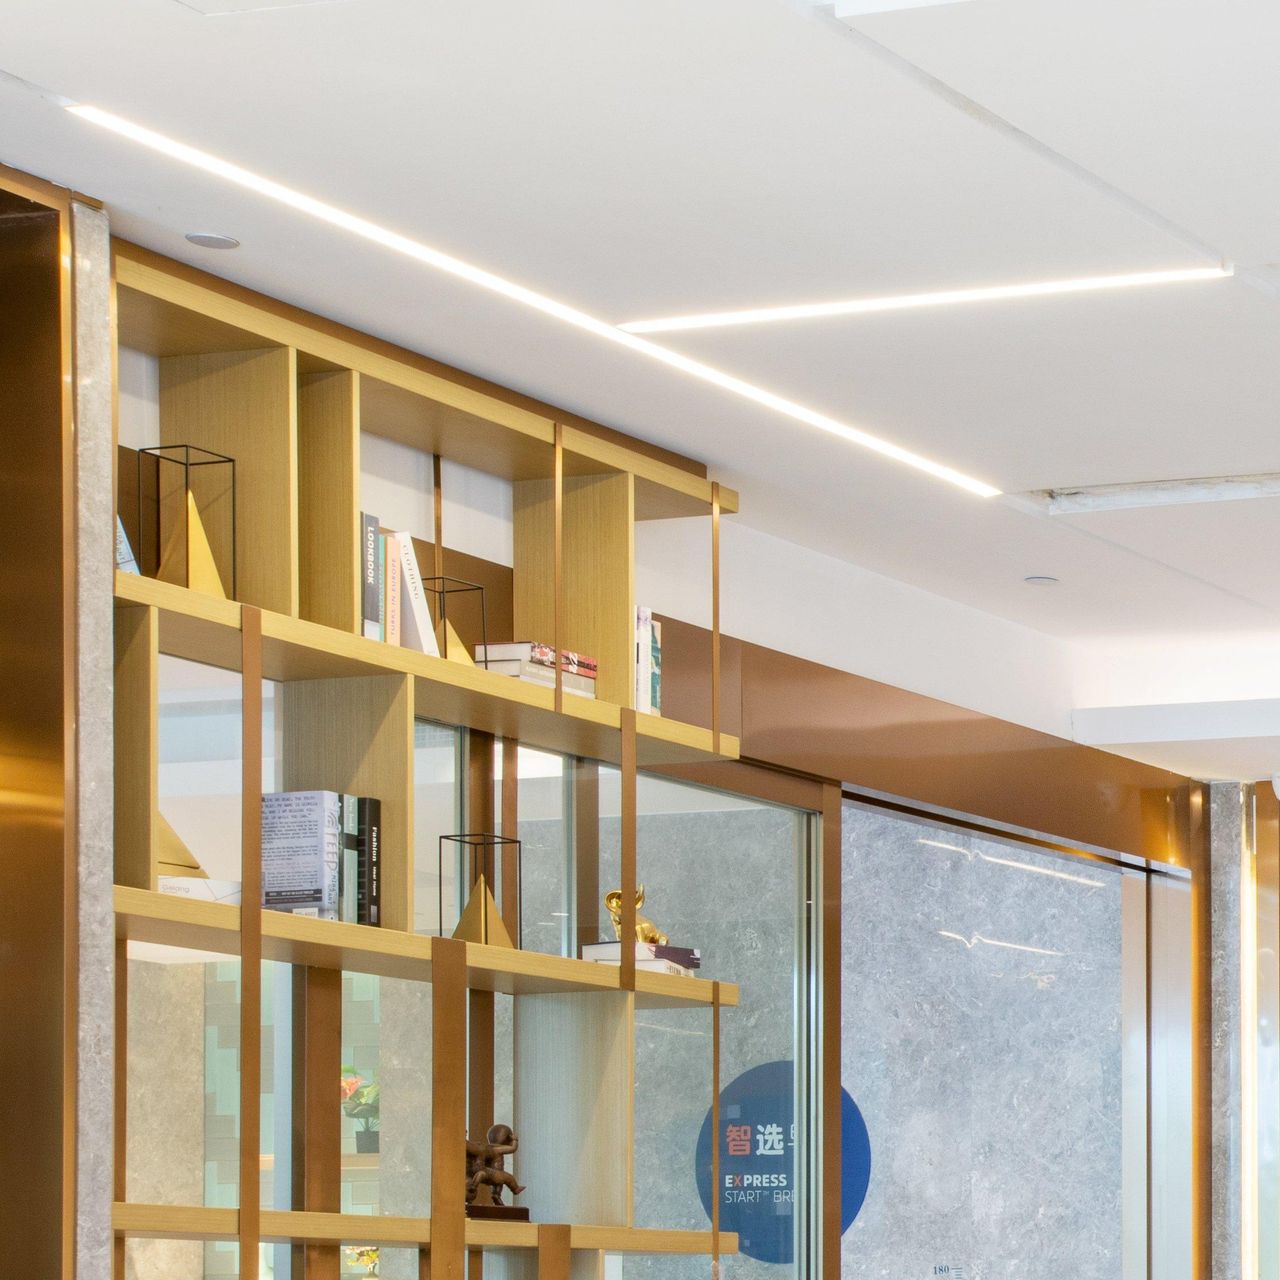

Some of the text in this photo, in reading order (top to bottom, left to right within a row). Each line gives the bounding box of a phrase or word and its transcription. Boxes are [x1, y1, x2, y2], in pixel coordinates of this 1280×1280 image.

[367, 526, 375, 584] LOOKBOOK
[403, 544, 419, 600] CLOTHING
[726, 1123, 795, 1156] 智选
[725, 1174, 788, 1188] EXPRESS
[933, 1265, 950, 1275] 180
